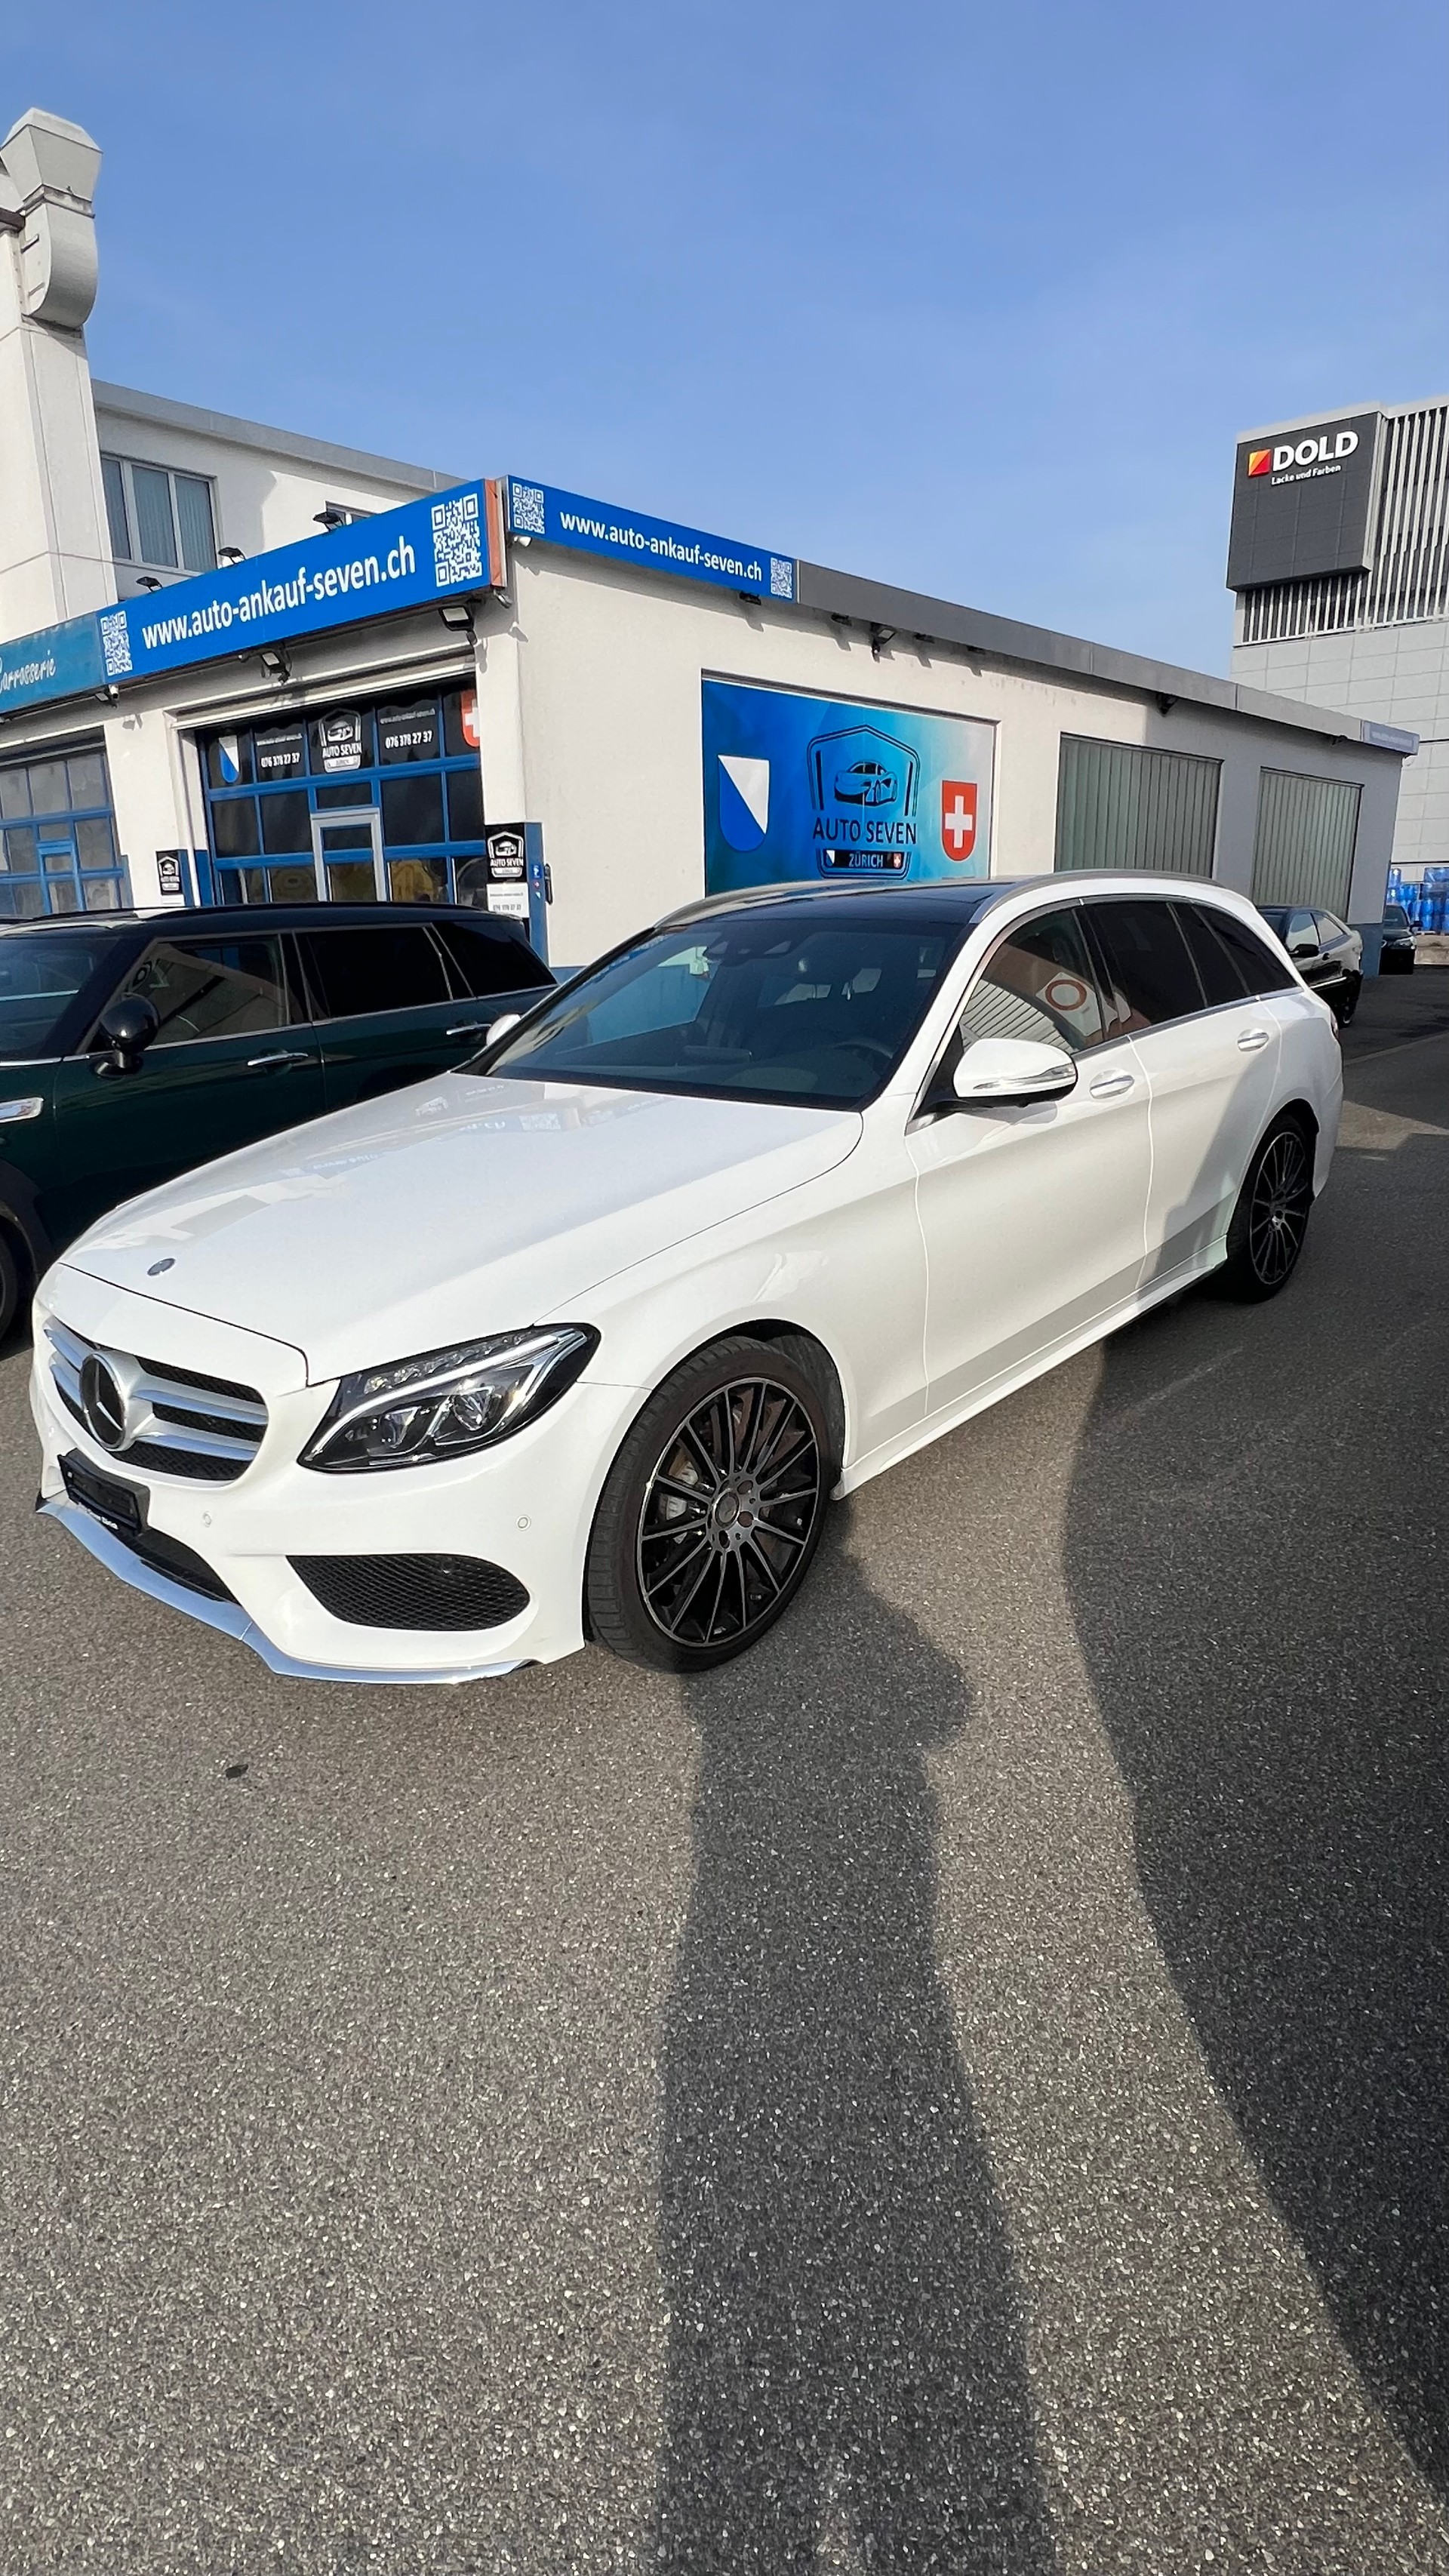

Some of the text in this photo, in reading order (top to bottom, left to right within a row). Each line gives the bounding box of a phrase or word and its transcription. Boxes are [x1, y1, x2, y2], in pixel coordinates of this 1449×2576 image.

[1272, 431, 1358, 472] DOLD
[1272, 465, 1342, 485] Lacke und Farben
[560, 512, 762, 581] www.auto-ankauf-seven.ch
[142, 535, 416, 650] www.auto-ankauf-seven.ch
[0, 649, 57, 694] arrosserie
[322, 743, 362, 759] AUTO SEVEN
[385, 735, 399, 749] 076
[412, 731, 423, 744] 27
[423, 730, 432, 743] 37
[813, 817, 917, 845] AUTO SEVEN
[849, 851, 884, 868] ZÜRICH
